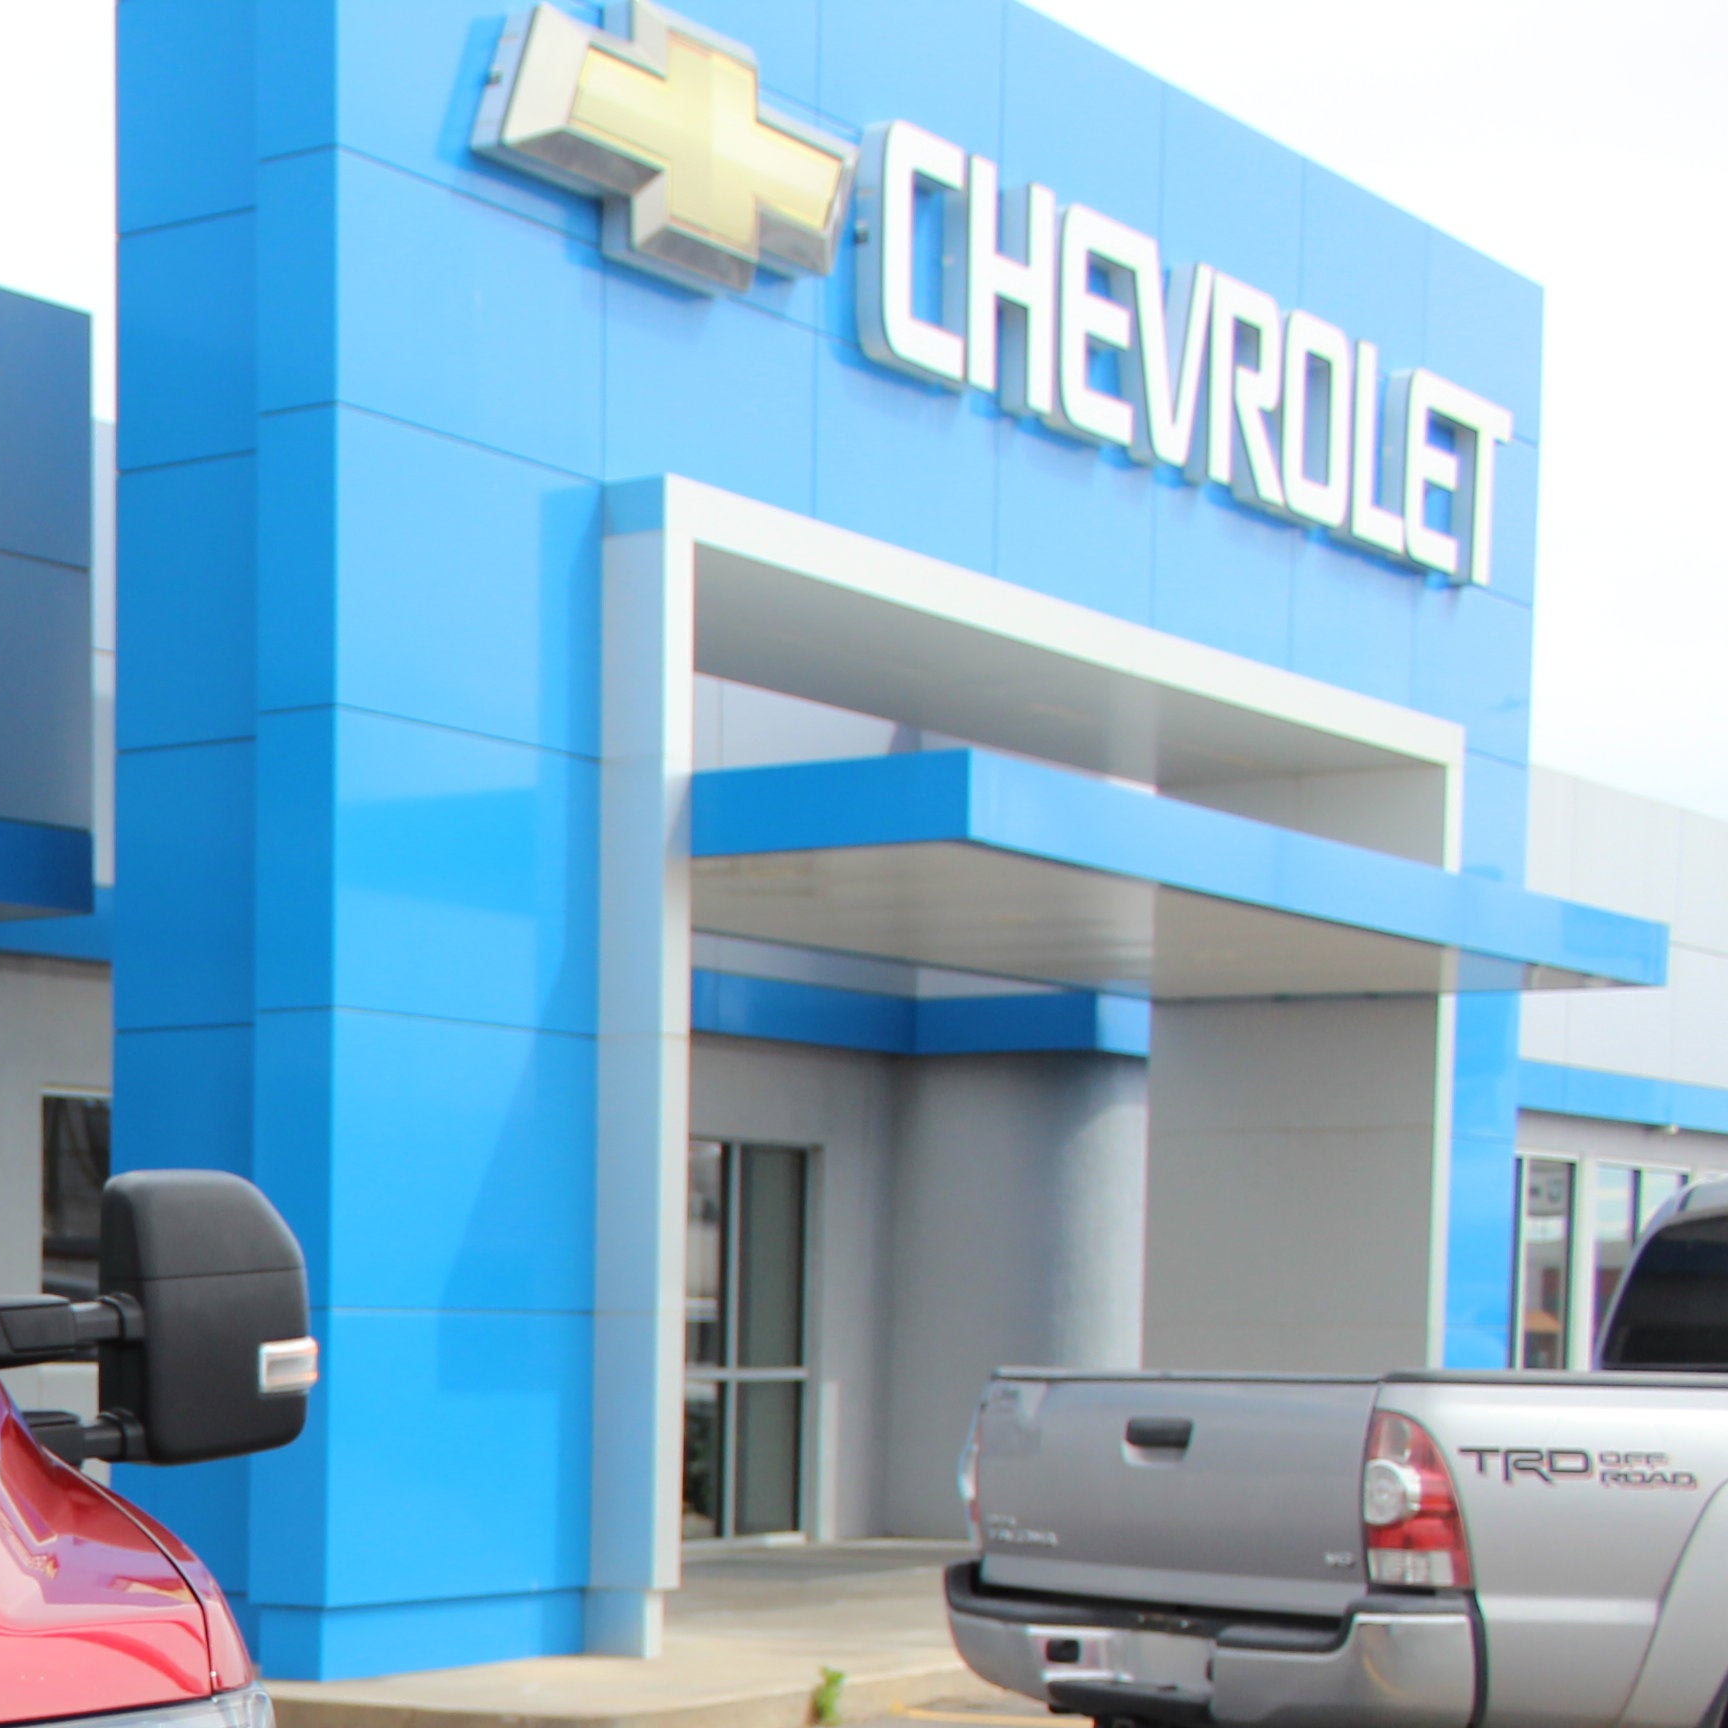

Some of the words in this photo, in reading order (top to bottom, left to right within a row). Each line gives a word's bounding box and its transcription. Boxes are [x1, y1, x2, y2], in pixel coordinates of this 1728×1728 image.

[857, 118, 1512, 587] CHEVROLET
[1457, 1447, 1593, 1484] TRD
[1599, 1450, 1668, 1467] OFF
[1600, 1470, 1698, 1489] ROAD
